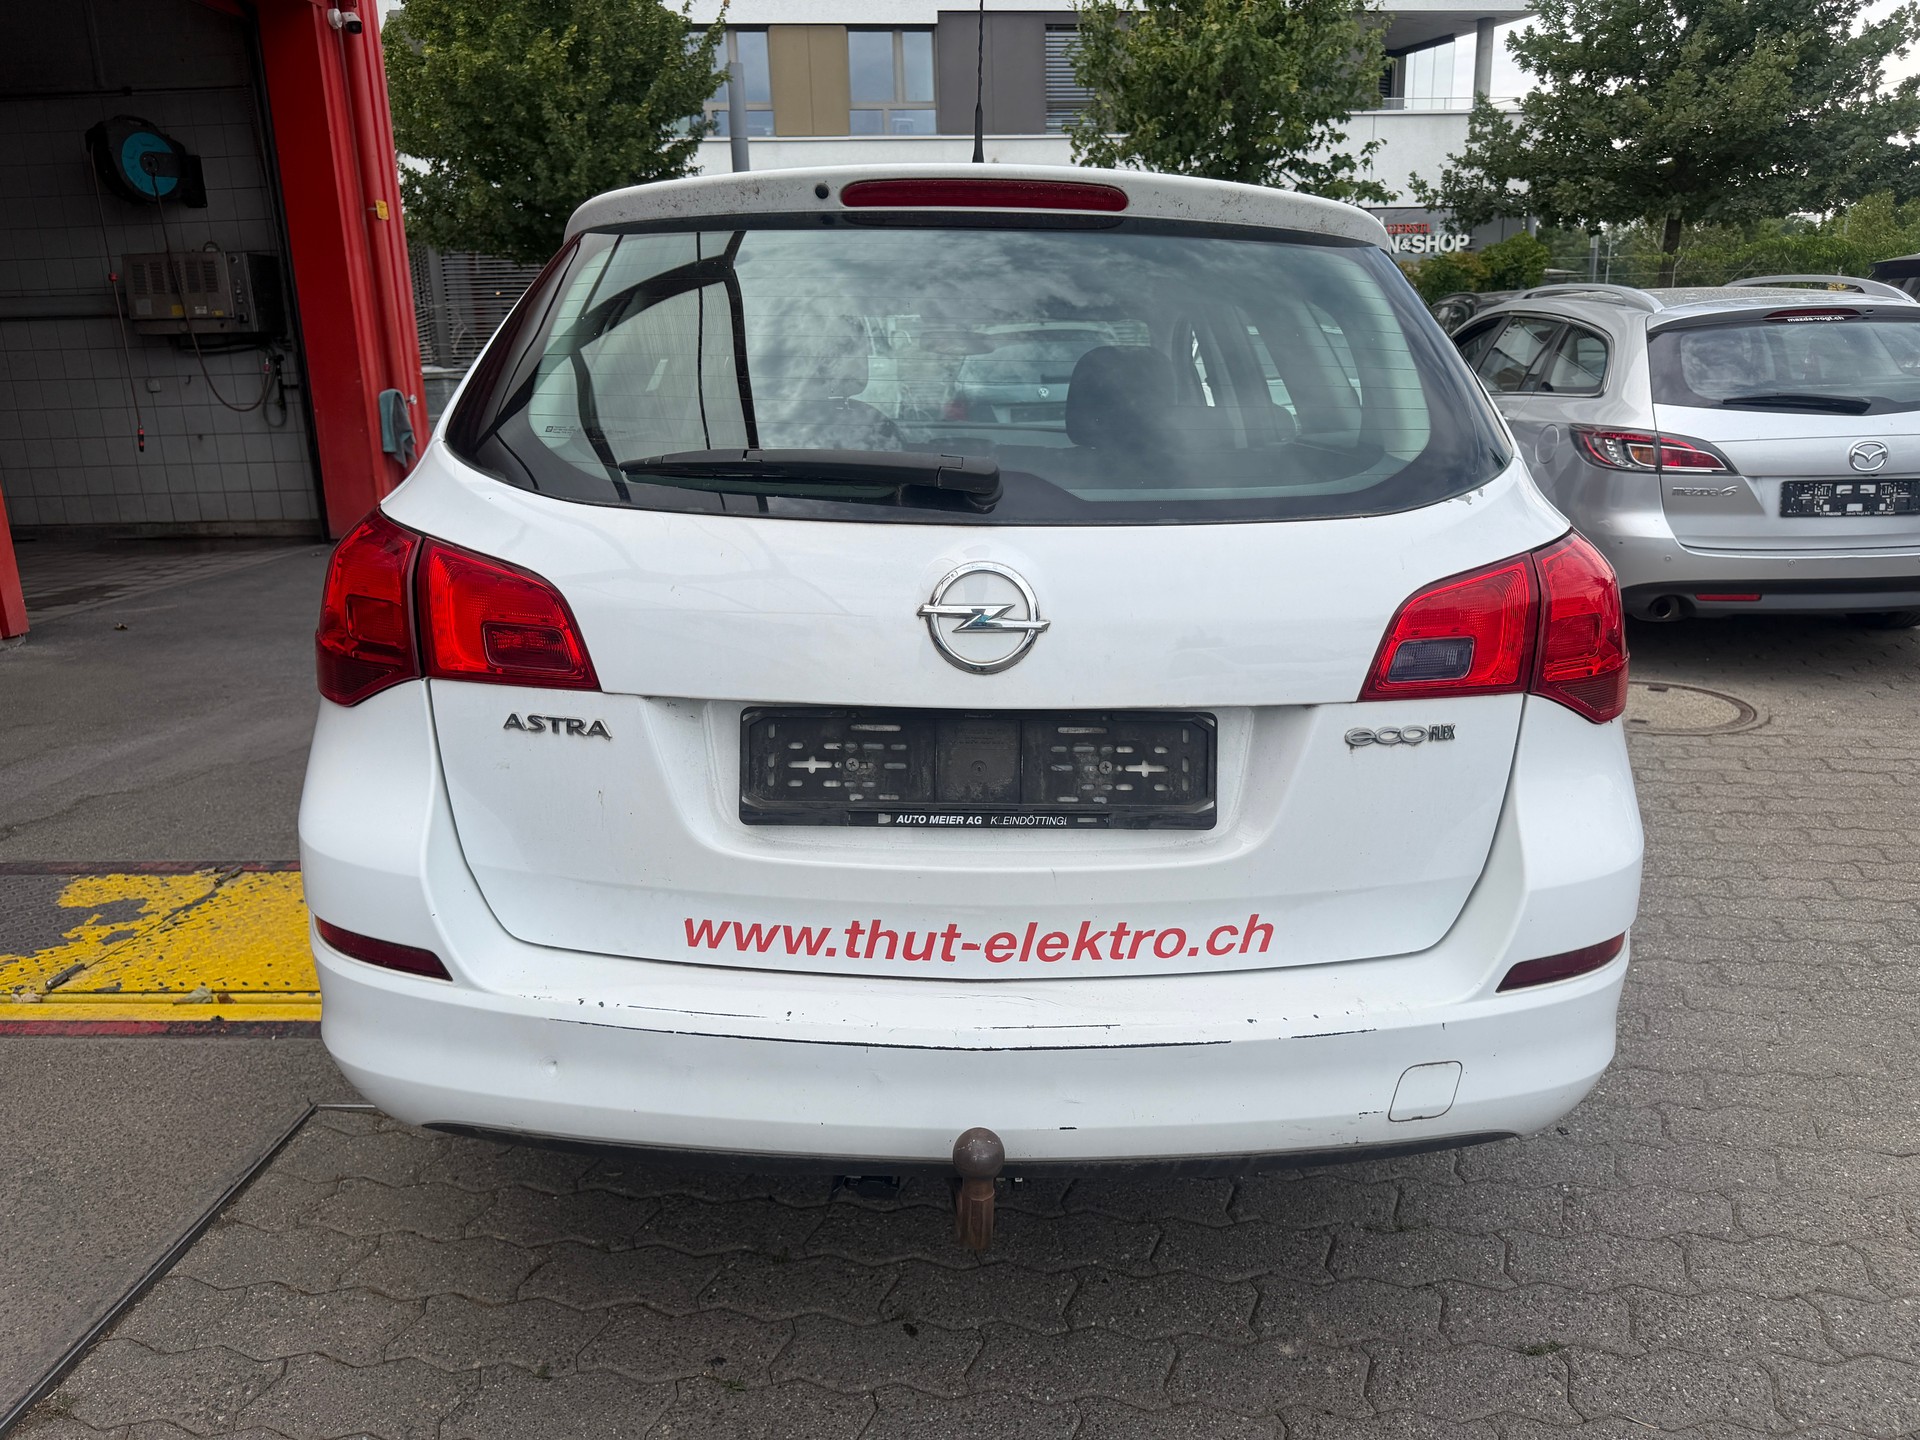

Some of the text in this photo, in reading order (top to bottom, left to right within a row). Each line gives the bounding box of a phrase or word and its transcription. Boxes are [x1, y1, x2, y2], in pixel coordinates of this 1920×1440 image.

[503, 712, 612, 740] ASTRA
[896, 814, 927, 824] AUTO
[929, 815, 965, 825] MEIER
[966, 815, 983, 825] AG
[684, 913, 1275, 963] www.thut-elektro.ch
